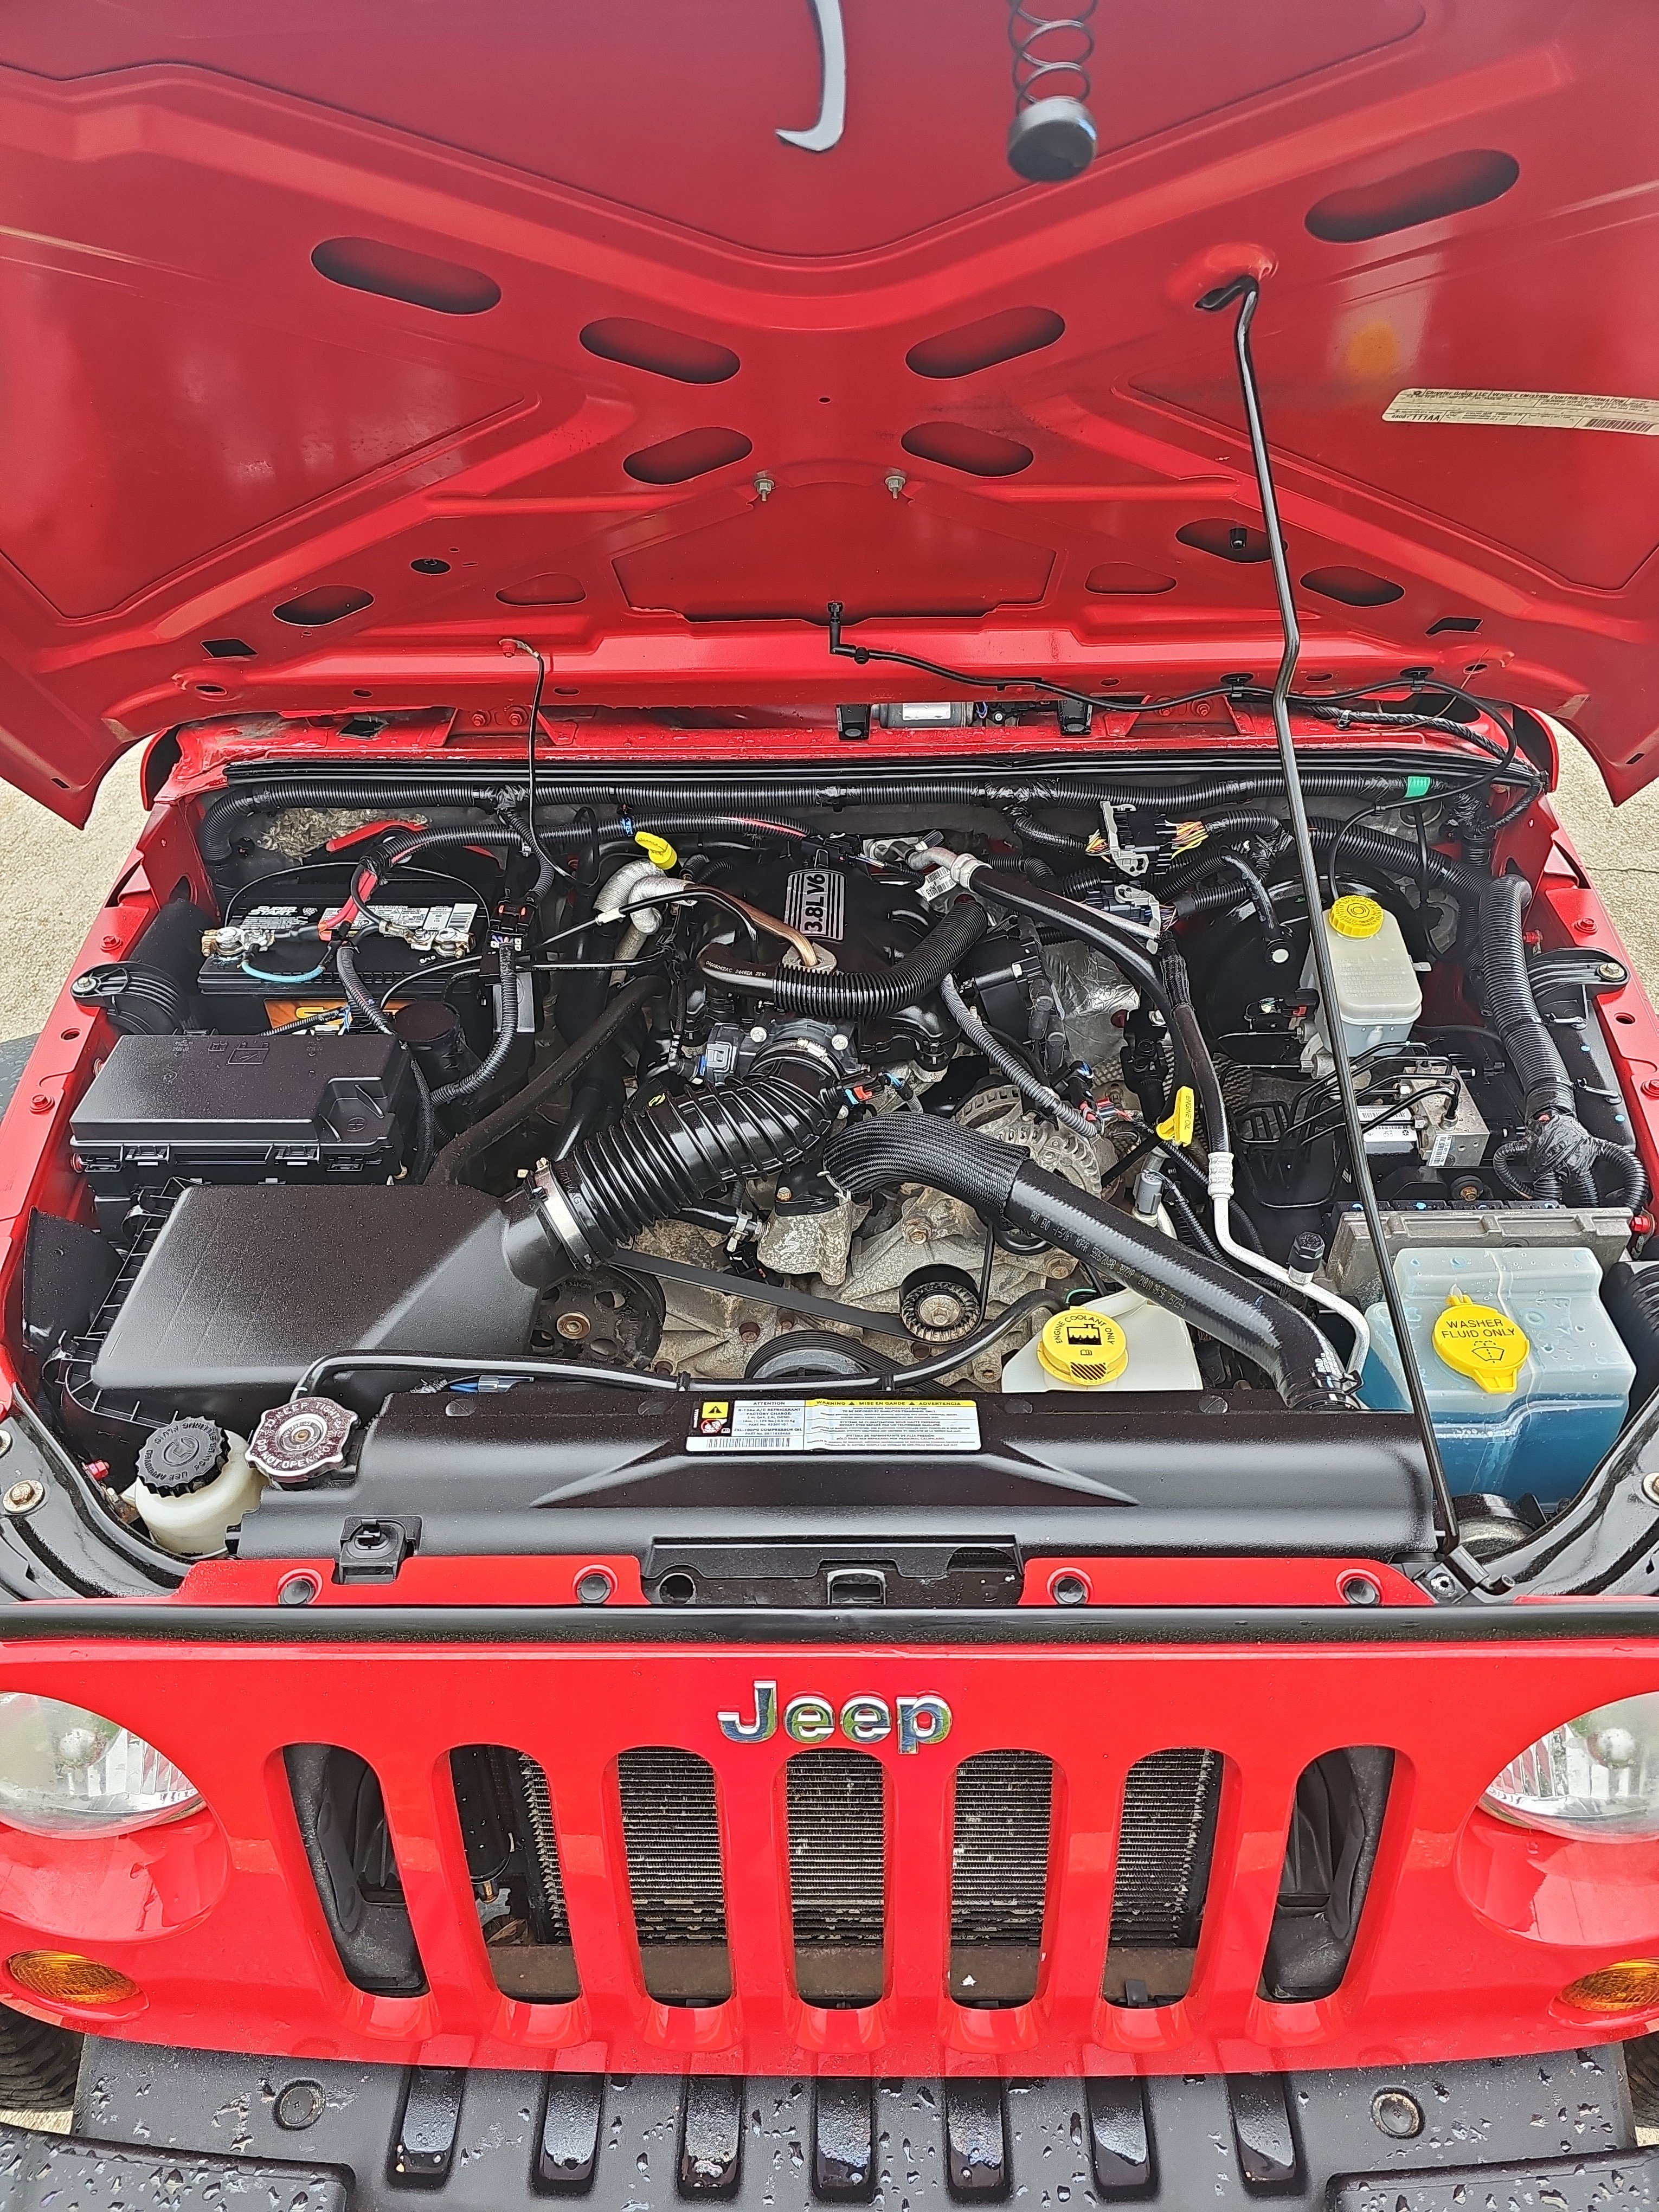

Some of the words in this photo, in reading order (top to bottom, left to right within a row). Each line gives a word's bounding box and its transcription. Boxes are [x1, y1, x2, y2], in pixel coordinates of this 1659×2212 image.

[806, 873, 826, 895] V6
[804, 896, 824, 933] 3.8L
[1053, 1321, 1065, 1345] ENGINE
[1065, 1315, 1107, 1327] COOLANT
[1104, 1327, 1115, 1345] ONLY
[1442, 1330, 1479, 1339] FLUID
[1483, 1328, 1515, 1337] ONLY
[1446, 1319, 1504, 1328] WASHER
[275, 1402, 308, 1419] KEEP
[717, 1680, 953, 1754] Jeep
